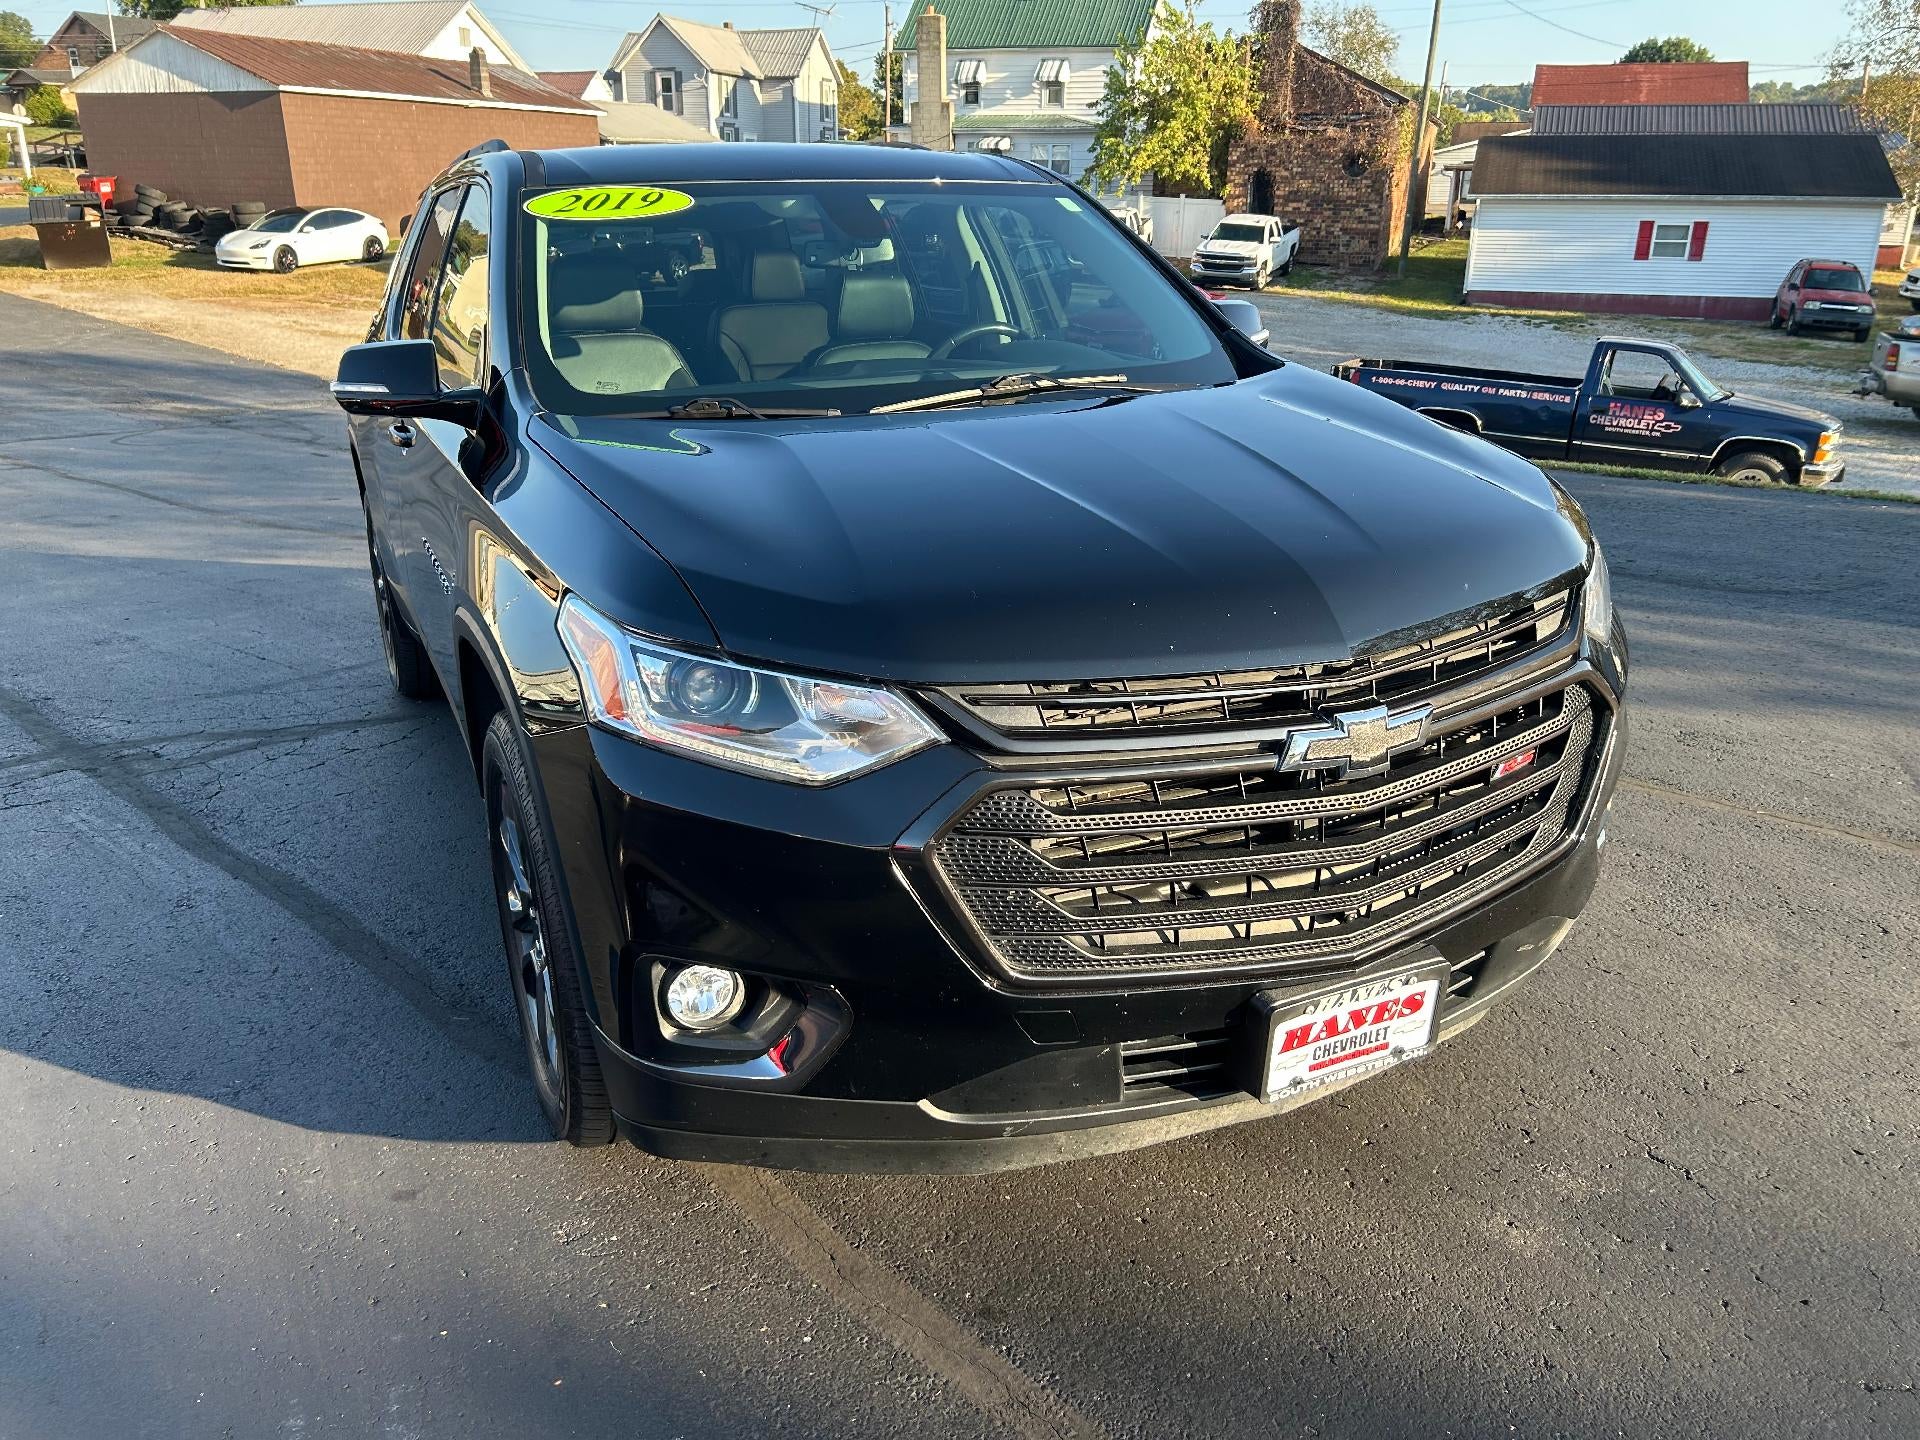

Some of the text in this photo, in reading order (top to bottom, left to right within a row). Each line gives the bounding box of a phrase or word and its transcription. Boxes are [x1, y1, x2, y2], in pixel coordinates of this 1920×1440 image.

[553, 190, 664, 213] 2019
[1441, 382, 1480, 393] QUALITY
[1481, 386, 1497, 395] GM
[1589, 414, 1655, 430] CHEVROLET
[1609, 402, 1666, 421] HANES
[1623, 428, 1651, 437] WEBSTER,
[1278, 990, 1426, 1055] HANES
[1312, 1025, 1391, 1061] CHEVROLET
[1269, 1048, 1428, 1103] SOUTH WEBSTER, OH.
